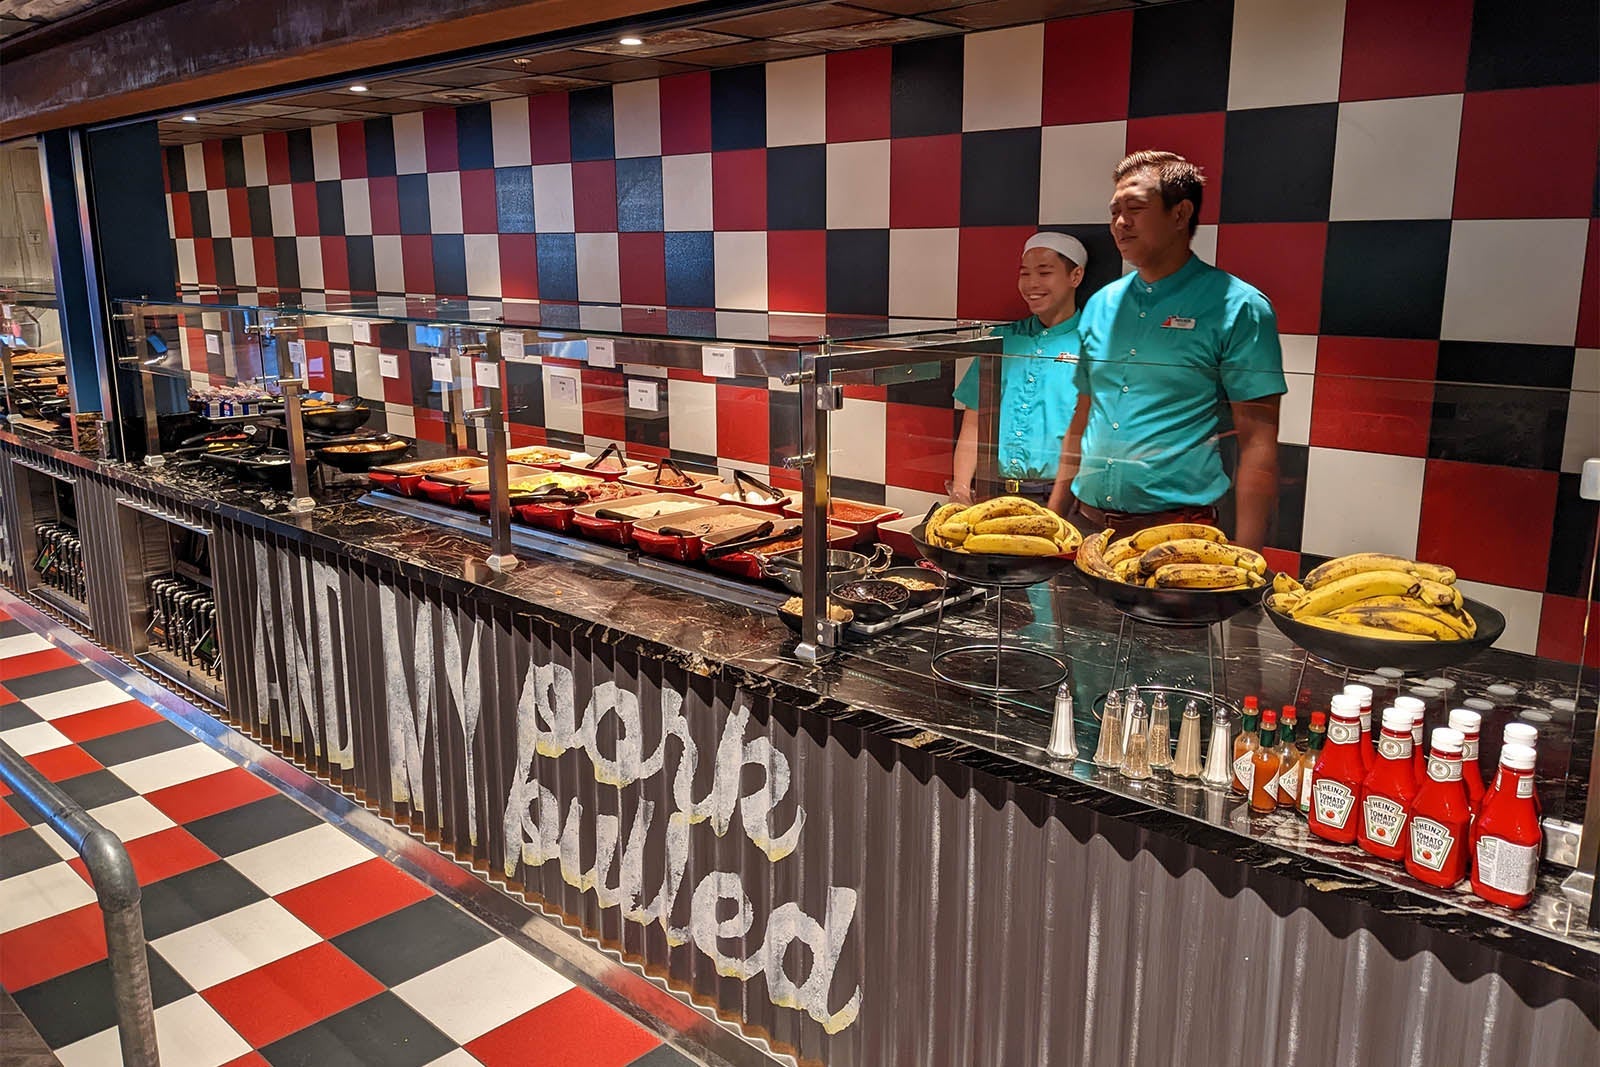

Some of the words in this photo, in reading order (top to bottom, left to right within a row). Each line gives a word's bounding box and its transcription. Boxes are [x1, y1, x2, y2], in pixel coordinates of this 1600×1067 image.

[253, 537, 355, 770] AND
[378, 576, 484, 847] MY
[1322, 784, 1344, 797] HEINZ
[1319, 792, 1346, 806] TOMATO
[1319, 799, 1344, 810] KETCHUP
[1372, 801, 1395, 814] HEINZ
[1370, 809, 1397, 823] TOMATO
[1370, 816, 1395, 828] KETCHUP
[1419, 823, 1442, 836] HEINZ
[1416, 830, 1444, 846] TOMATO
[1416, 838, 1442, 850] KETCHUP
